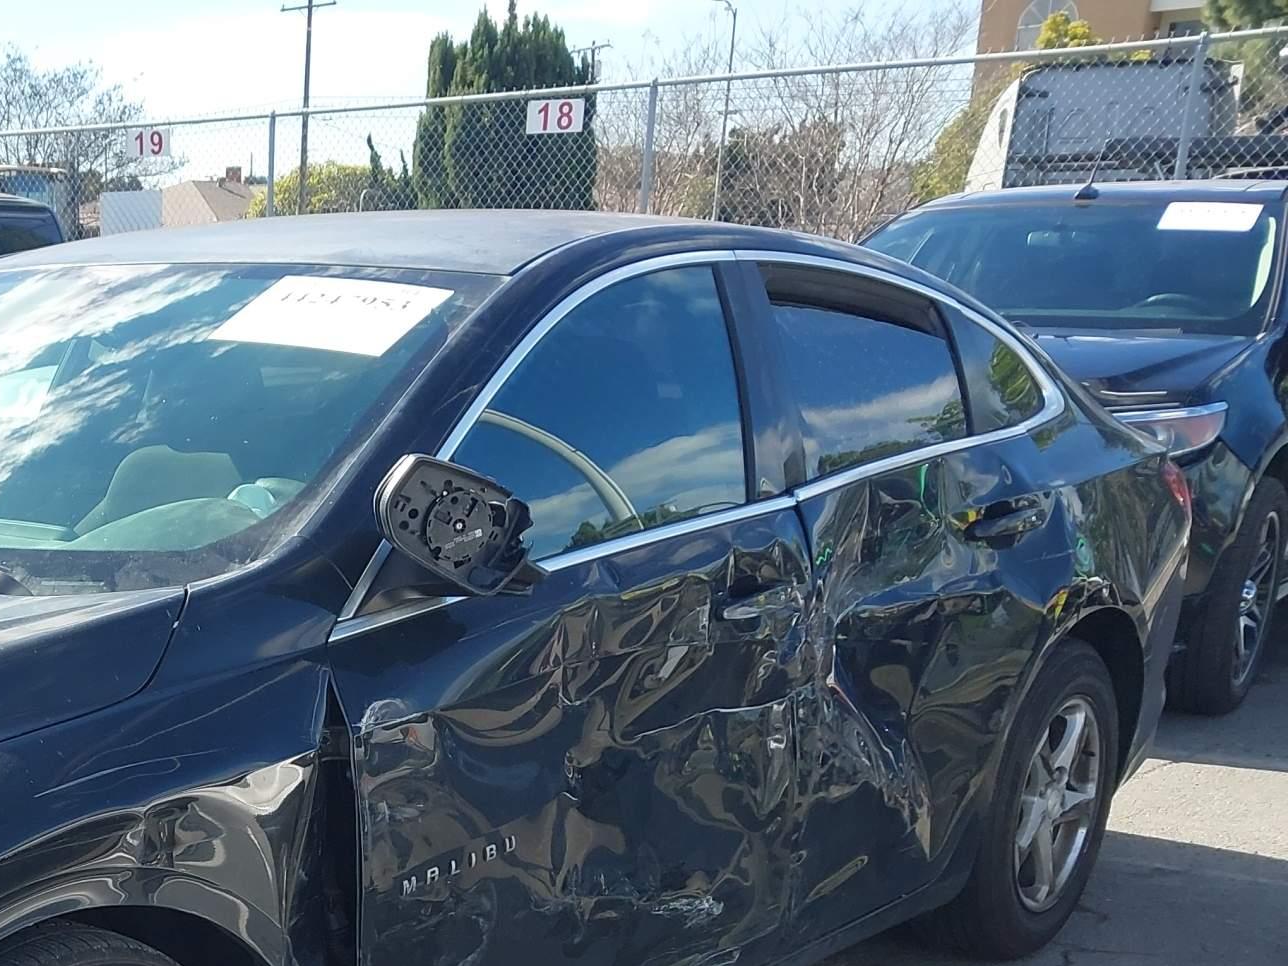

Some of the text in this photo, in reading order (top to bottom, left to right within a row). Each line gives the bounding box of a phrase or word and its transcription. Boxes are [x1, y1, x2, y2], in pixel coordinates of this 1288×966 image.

[538, 101, 573, 131] 18
[134, 130, 163, 156] 19
[401, 834, 516, 897] MALIBU
